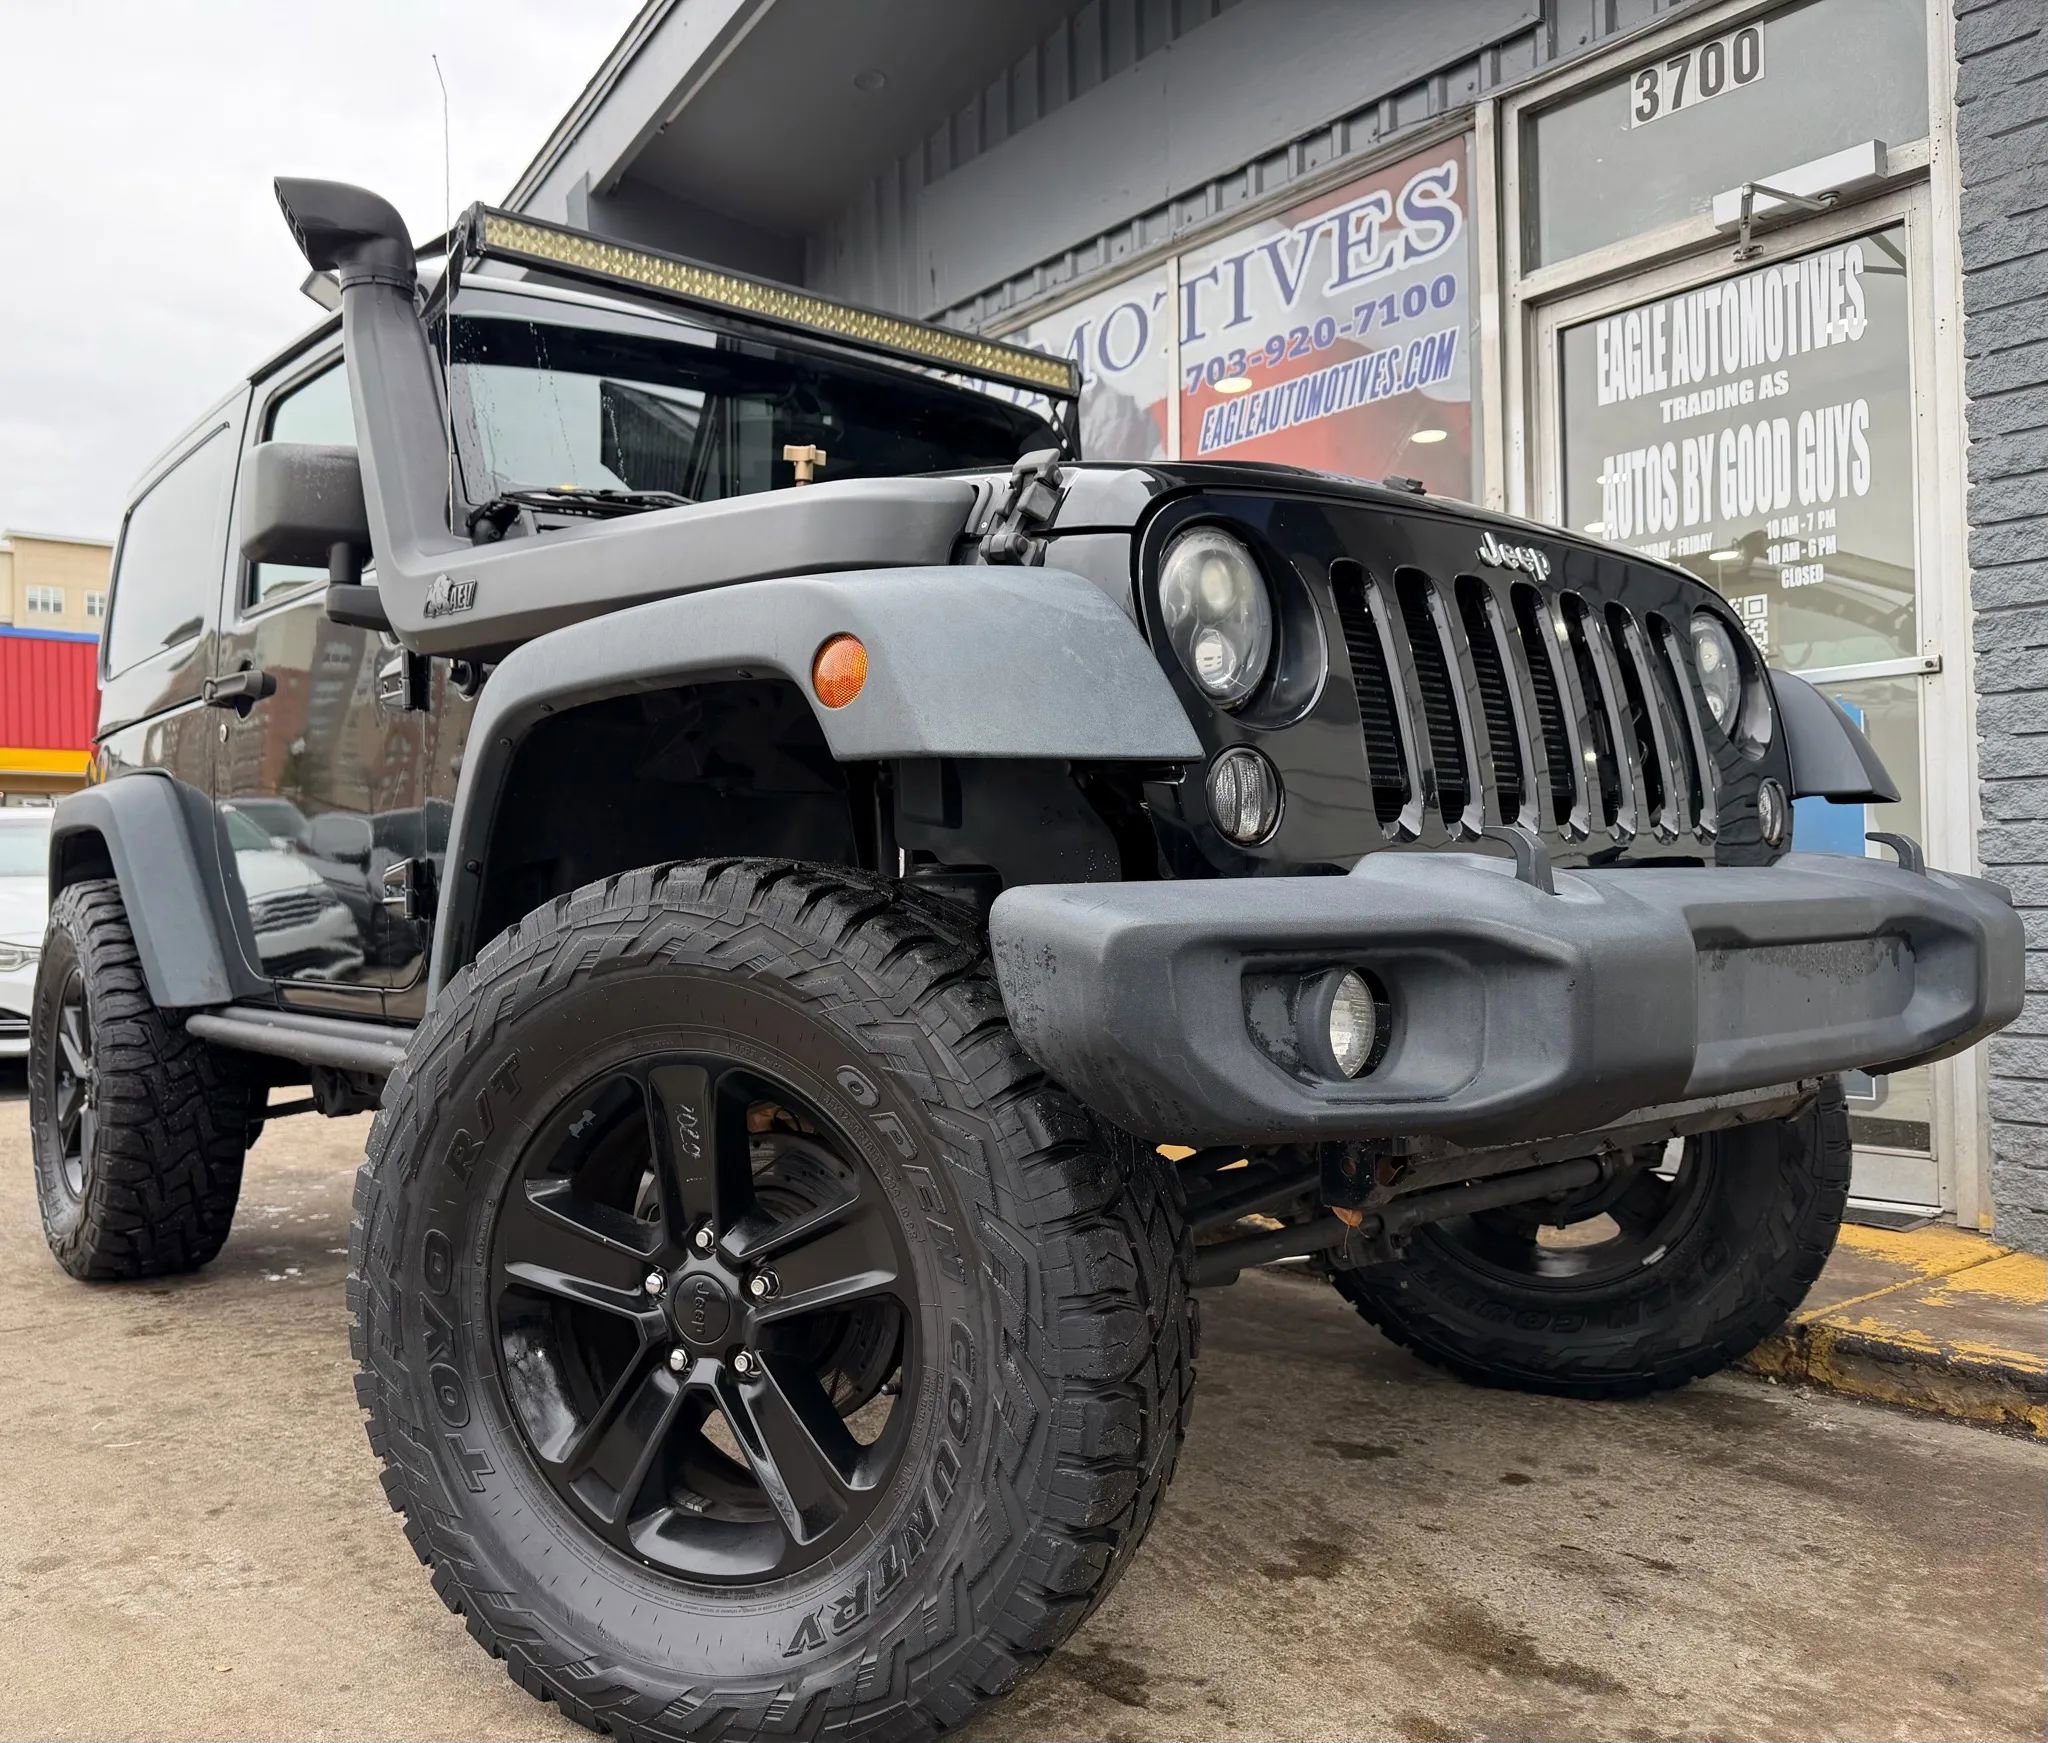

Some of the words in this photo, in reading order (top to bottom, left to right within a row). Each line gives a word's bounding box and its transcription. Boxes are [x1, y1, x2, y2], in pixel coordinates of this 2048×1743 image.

[1634, 27, 1760, 123] 3700
[1185, 273, 1458, 395] 703-920-7100
[1597, 303, 1668, 407] EAGLE
[1671, 244, 1866, 388] AUTOMOTIVES
[1199, 327, 1459, 454] EAGLEAUTOMOTIVES.COM
[1659, 379, 1754, 423] TRADING
[1758, 370, 1789, 401] AS
[1601, 441, 1679, 542] AUTOS
[1681, 433, 1715, 527] BY
[1719, 417, 1791, 521] GOOD
[1796, 398, 1871, 507] GUYS
[1475, 532, 1551, 582] Jeep
[1635, 540, 1671, 560] NDAY
[1677, 531, 1713, 557] FRIDAY
[1765, 519, 1780, 540] 10
[1781, 515, 1799, 537] AM
[1806, 512, 1814, 531] 7
[1817, 508, 1836, 530] PM
[1766, 545, 1781, 566] 10
[1781, 541, 1800, 564] AM
[1808, 538, 1817, 559] 6
[1818, 534, 1837, 557] PM
[450, 583, 475, 609] AEV
[1781, 563, 1824, 589] CLOSED
[443, 1051, 521, 1191] R/T
[835, 1063, 968, 1286] OPEN
[691, 1281, 710, 1336] Jeep
[419, 1229, 495, 1492] TOYO
[782, 1317, 974, 1658] COUNTRY
